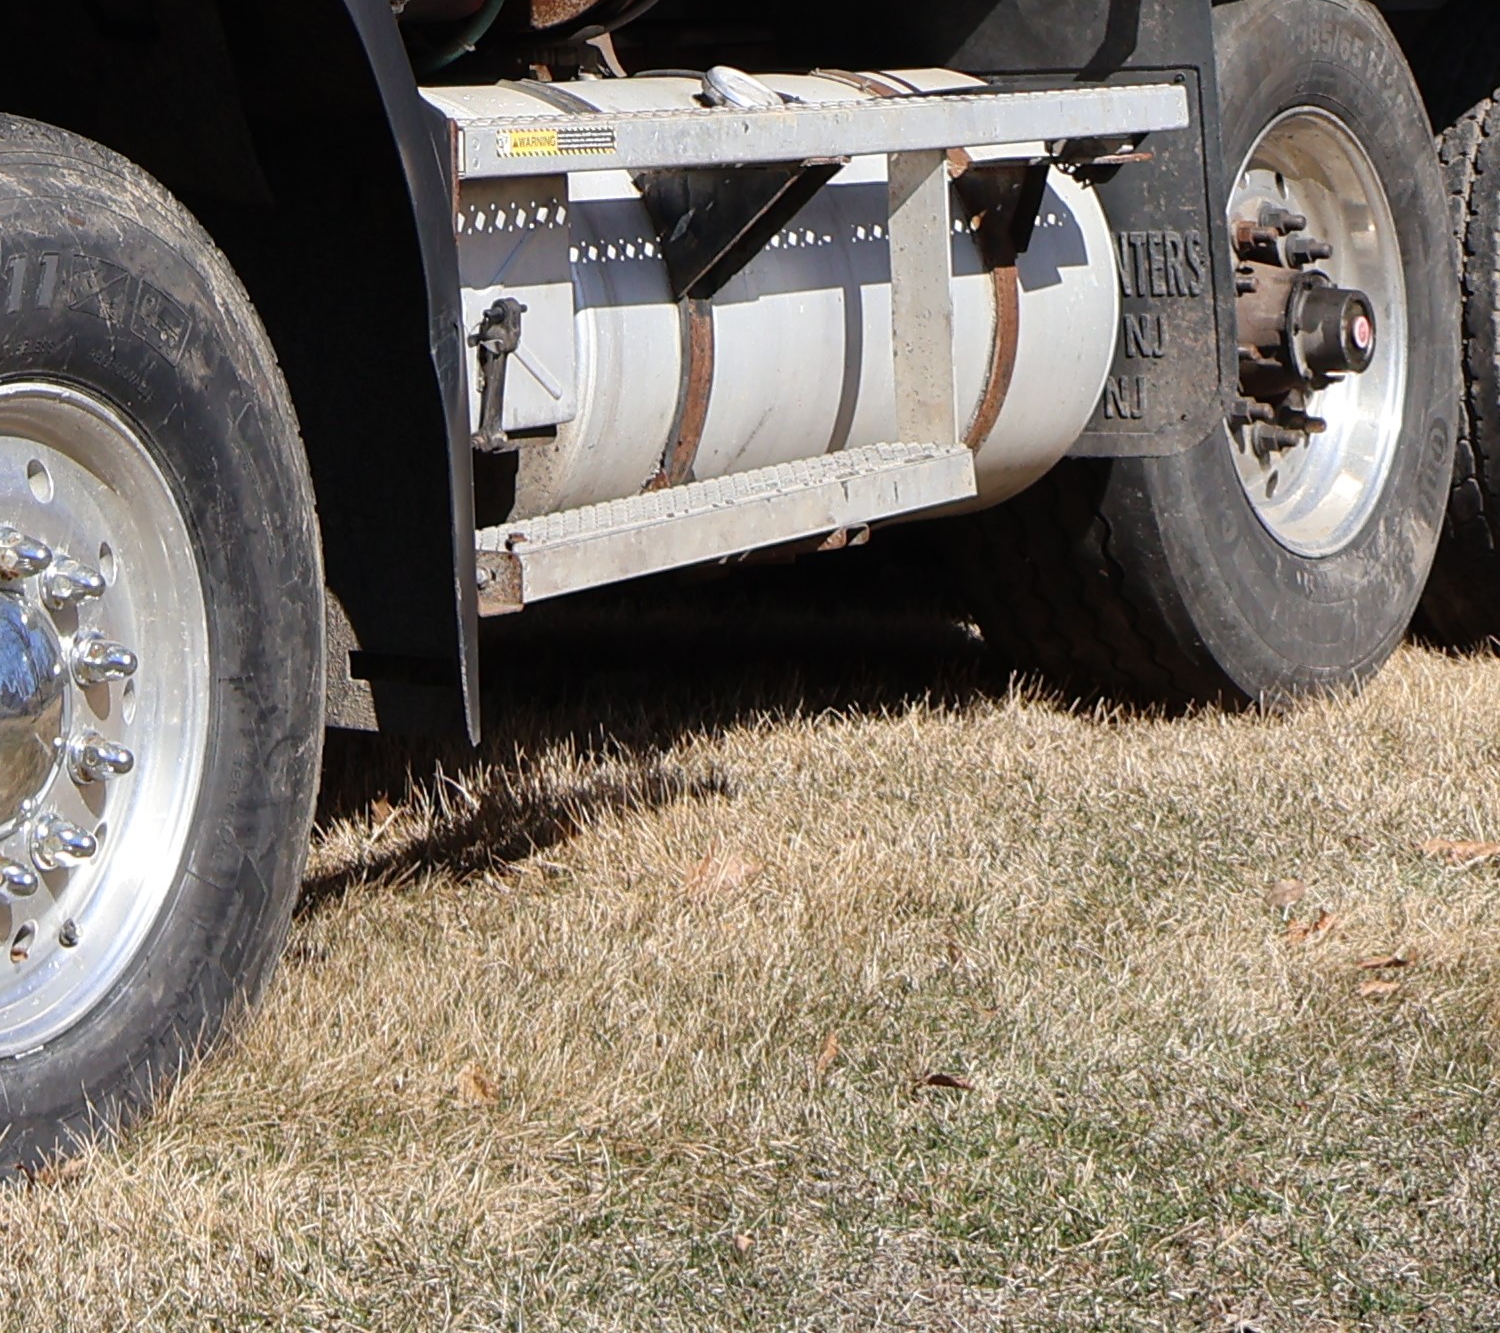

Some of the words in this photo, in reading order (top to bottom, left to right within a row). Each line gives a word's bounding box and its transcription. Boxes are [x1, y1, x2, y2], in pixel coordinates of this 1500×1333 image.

[519, 135, 556, 148] WARNING
[1116, 230, 1205, 298] NTERS
[1123, 312, 1165, 358] NJ
[1103, 375, 1147, 420] NJ
